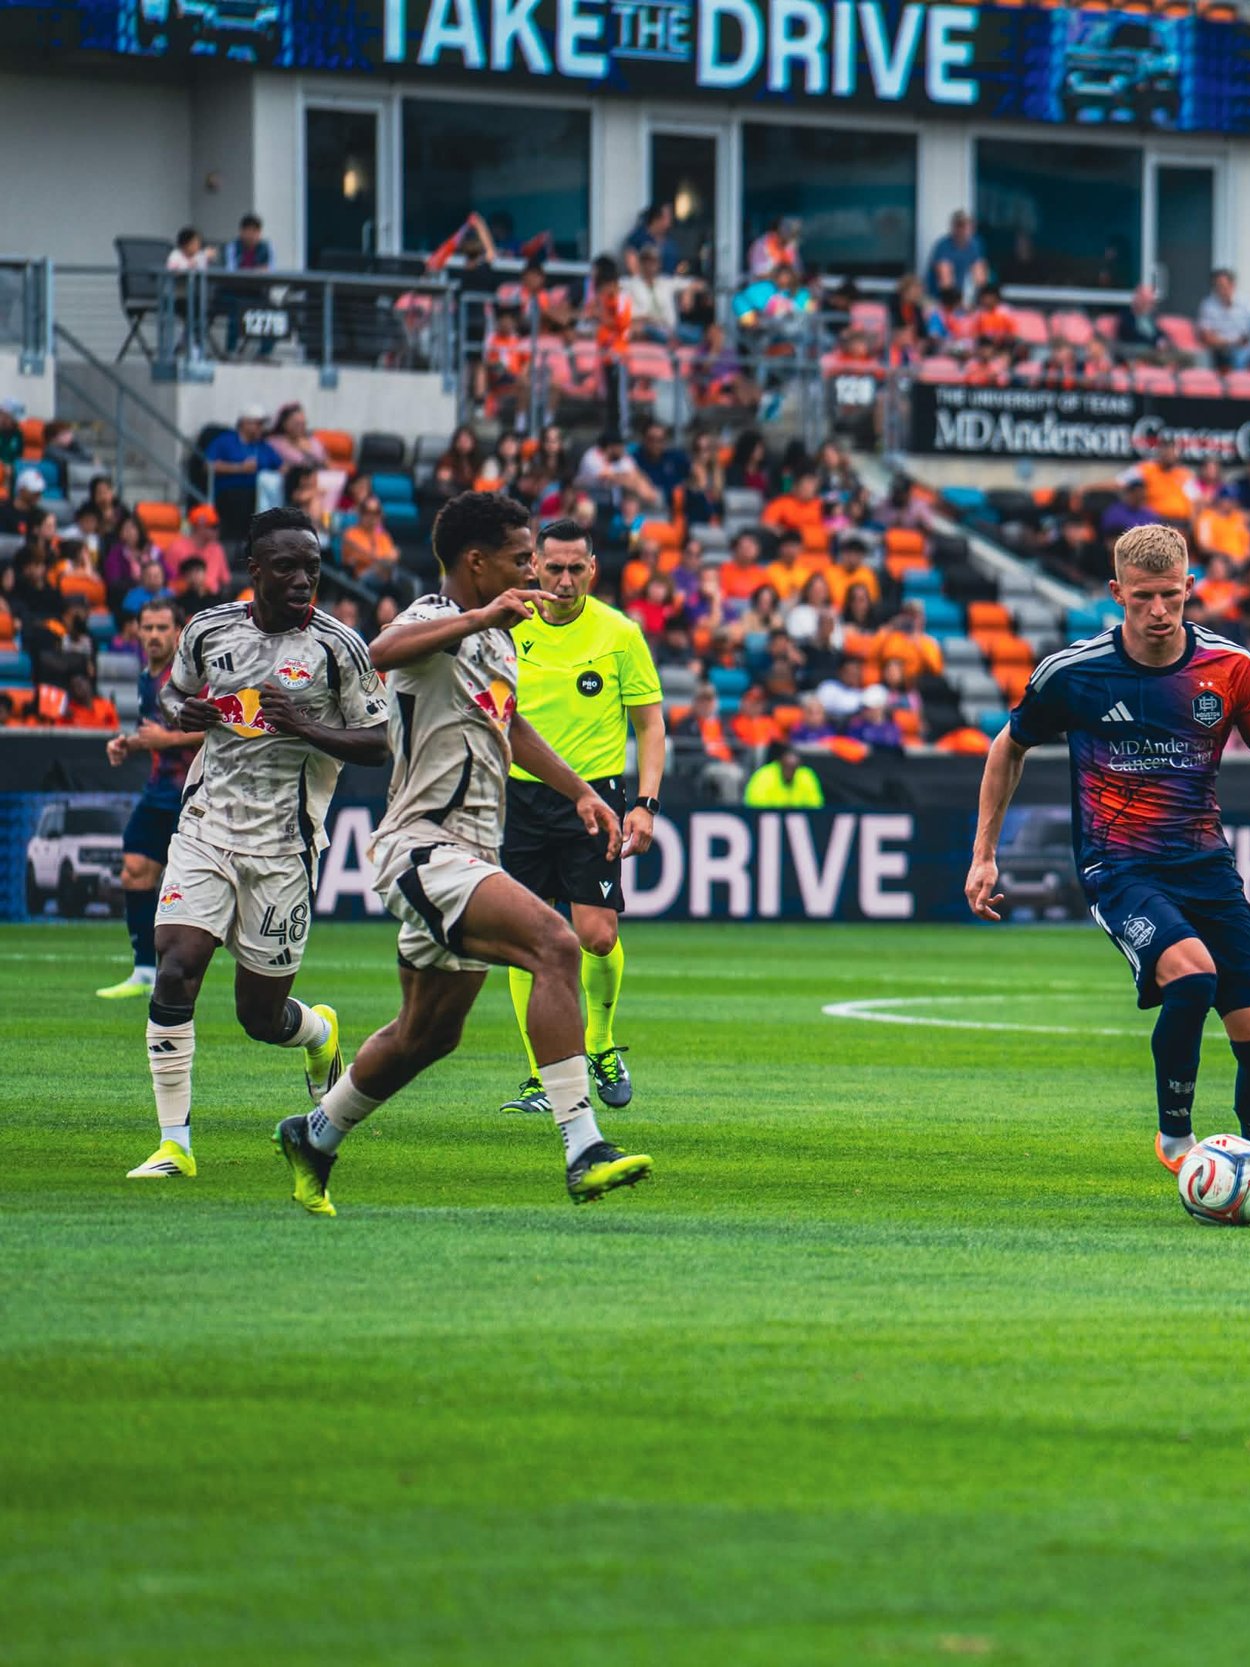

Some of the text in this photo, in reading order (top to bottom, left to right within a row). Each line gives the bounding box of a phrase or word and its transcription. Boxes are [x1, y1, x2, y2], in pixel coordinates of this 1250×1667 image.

[612, 5, 691, 52] THE
[696, 0, 979, 104] DRIVE
[1108, 749, 1213, 772] Cancer Center
[620, 811, 914, 919] DRIVE
[259, 902, 308, 946] 48
